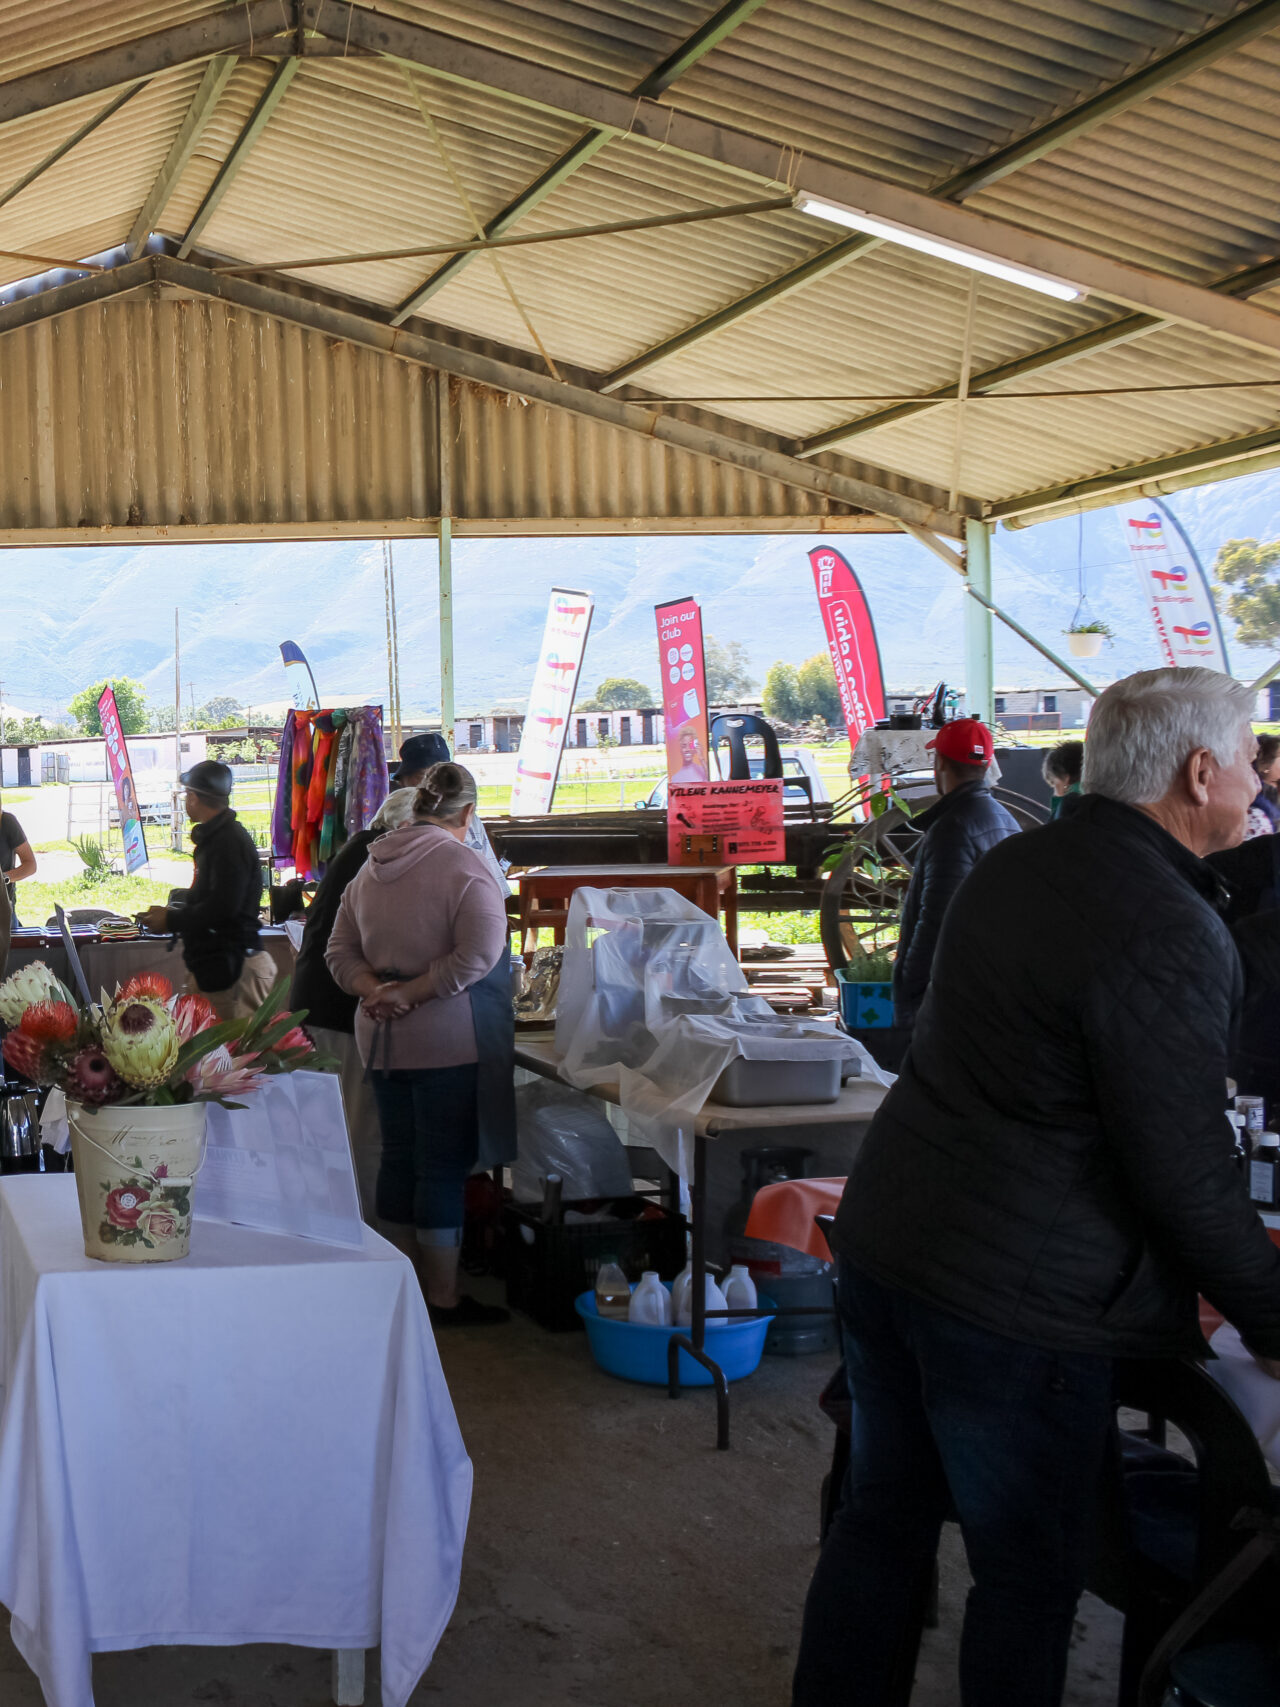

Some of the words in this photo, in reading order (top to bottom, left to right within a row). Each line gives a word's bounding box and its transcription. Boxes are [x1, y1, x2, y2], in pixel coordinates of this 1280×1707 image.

[660, 615, 679, 628] Join
[680, 611, 696, 622] our
[661, 627, 682, 641] Club
[834, 608, 852, 656] vida
[670, 787, 707, 797] VILENE
[710, 785, 780, 796] KANNEMEYER
